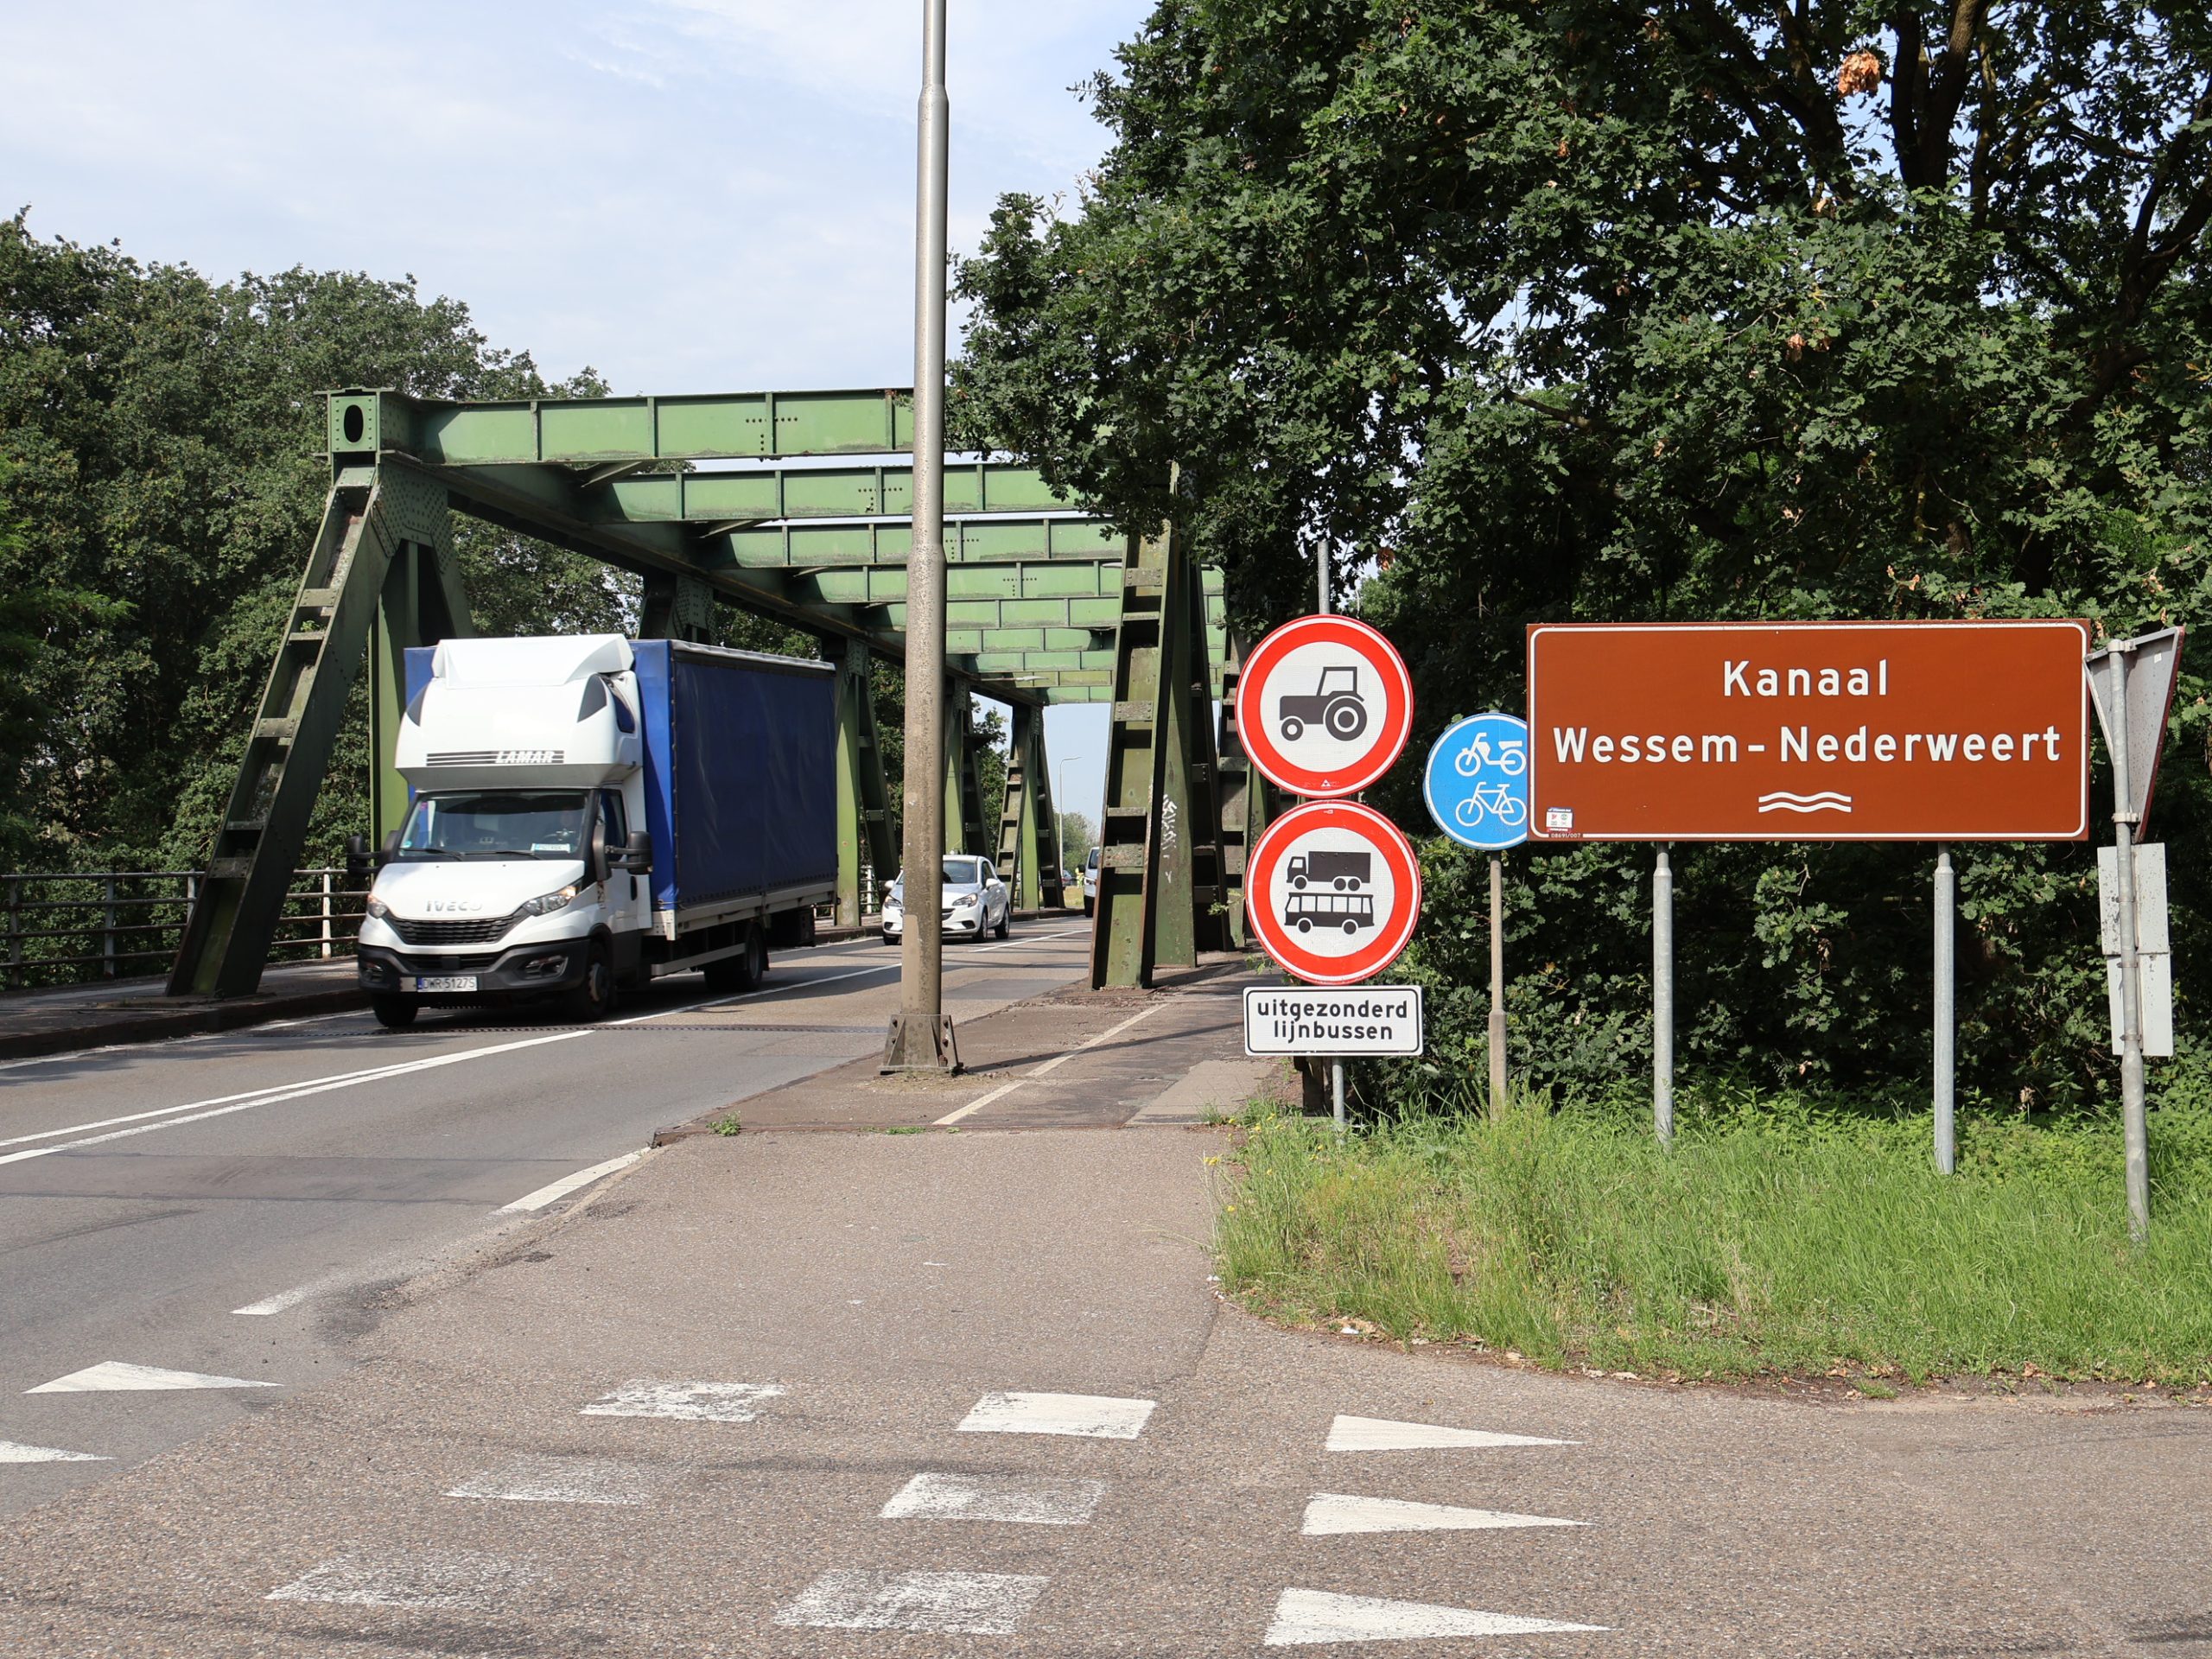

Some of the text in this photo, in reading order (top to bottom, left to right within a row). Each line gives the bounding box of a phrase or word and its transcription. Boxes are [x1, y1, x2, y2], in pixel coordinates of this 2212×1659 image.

[1725, 659, 1888, 696] Kanaal
[495, 750, 554, 764] LAMAR
[1257, 1000, 1408, 1021] uitgezonderd
[1274, 1020, 1393, 1043] lijnbussen
